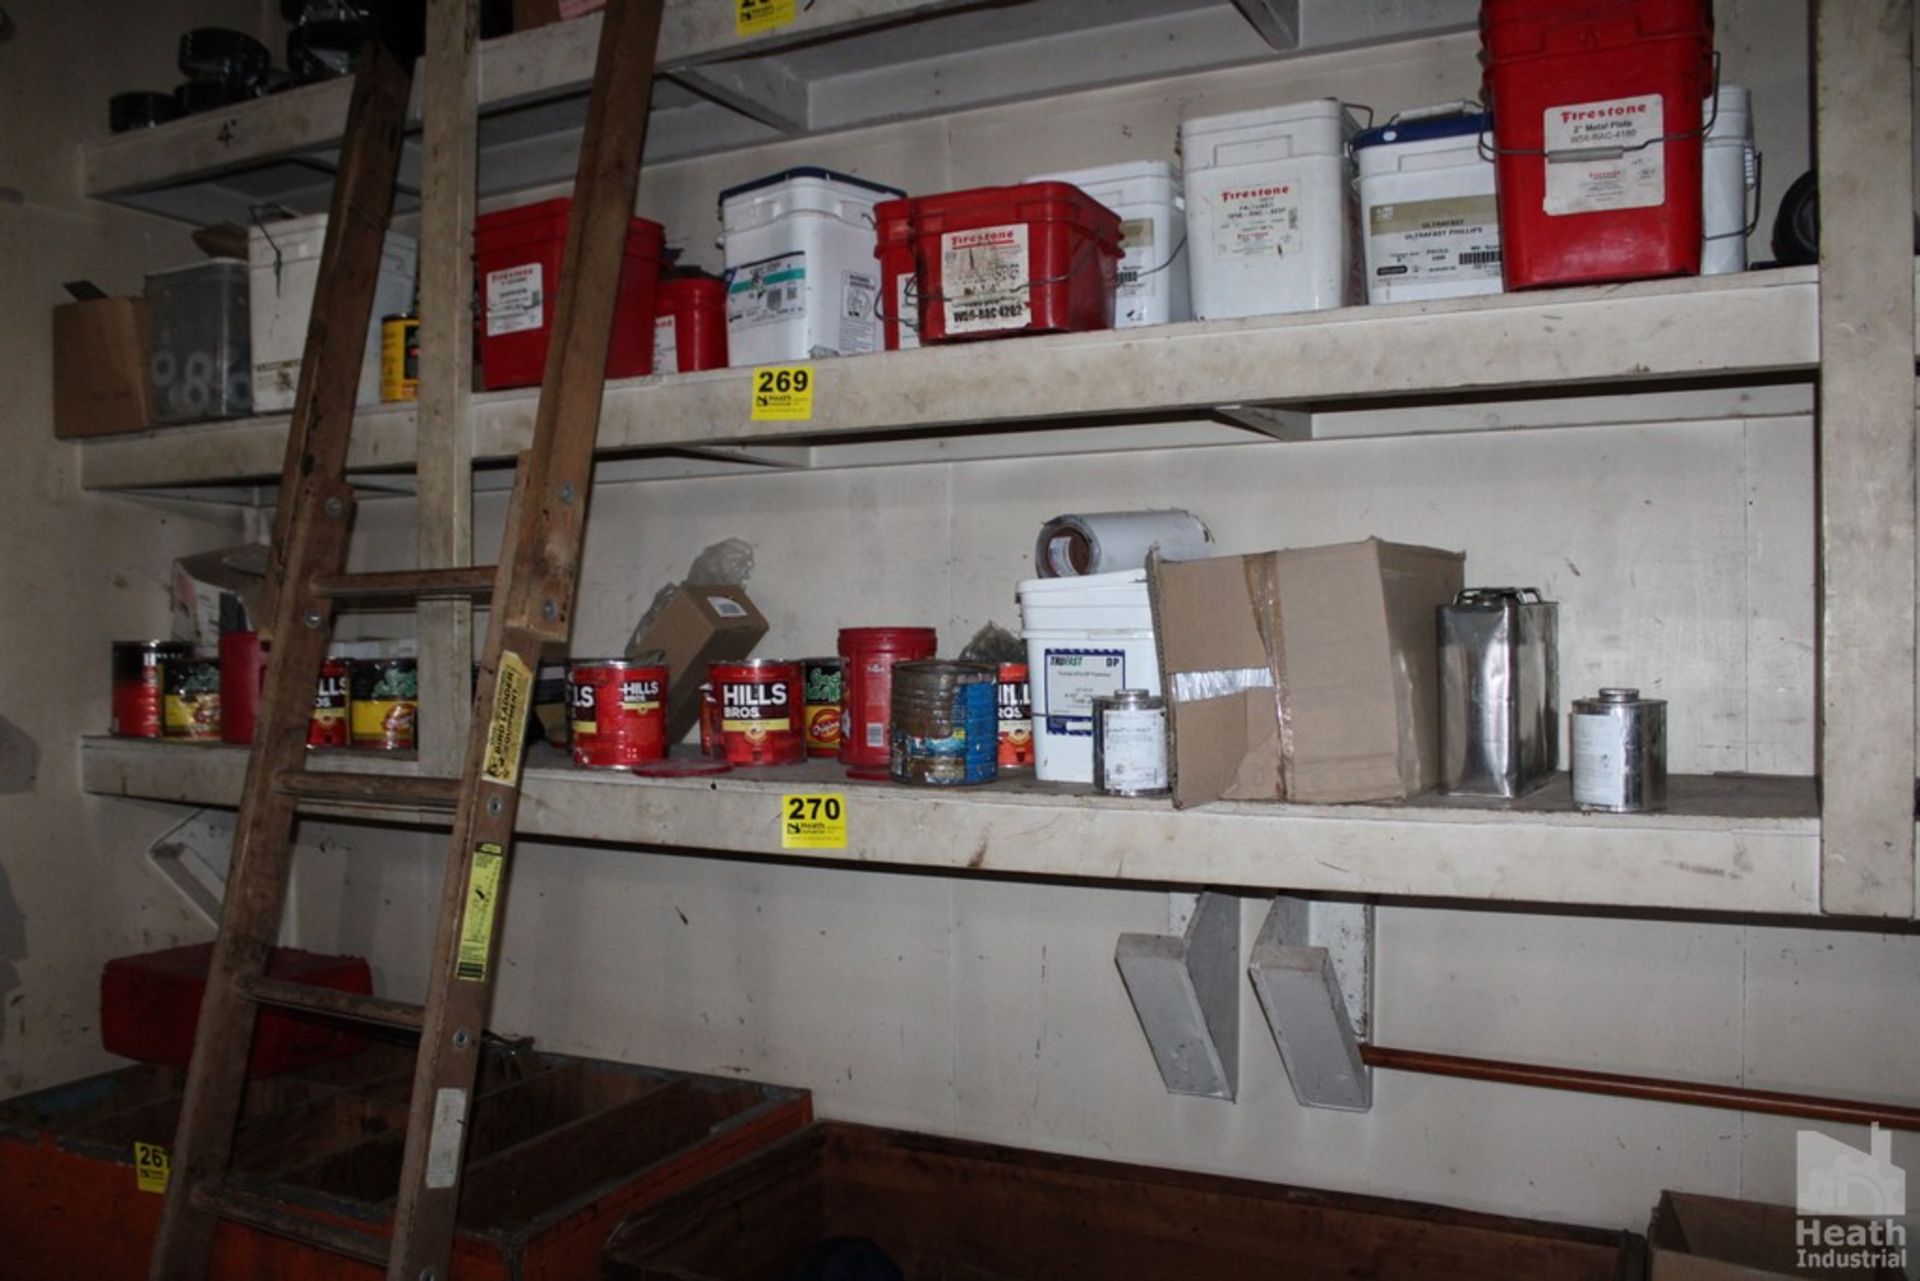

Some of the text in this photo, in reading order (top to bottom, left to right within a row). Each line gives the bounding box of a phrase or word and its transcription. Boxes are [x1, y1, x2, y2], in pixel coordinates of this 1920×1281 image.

[1561, 103, 1647, 123] Firestone
[1222, 185, 1290, 202] Firestone
[1404, 226, 1483, 240] ULTRAFAST PHILLIPS
[1421, 218, 1465, 230] ULTRAFAST
[951, 230, 1014, 246] Firestone
[758, 370, 809, 393] 269
[1106, 658, 1120, 667] DP
[318, 677, 347, 697] LLS
[623, 681, 659, 695] HILLS
[723, 683, 788, 706] HILLS
[499, 672, 514, 722] LADDER
[723, 706, 761, 719] BROS.
[789, 798, 841, 821] 270
[140, 1146, 169, 1168] 26
